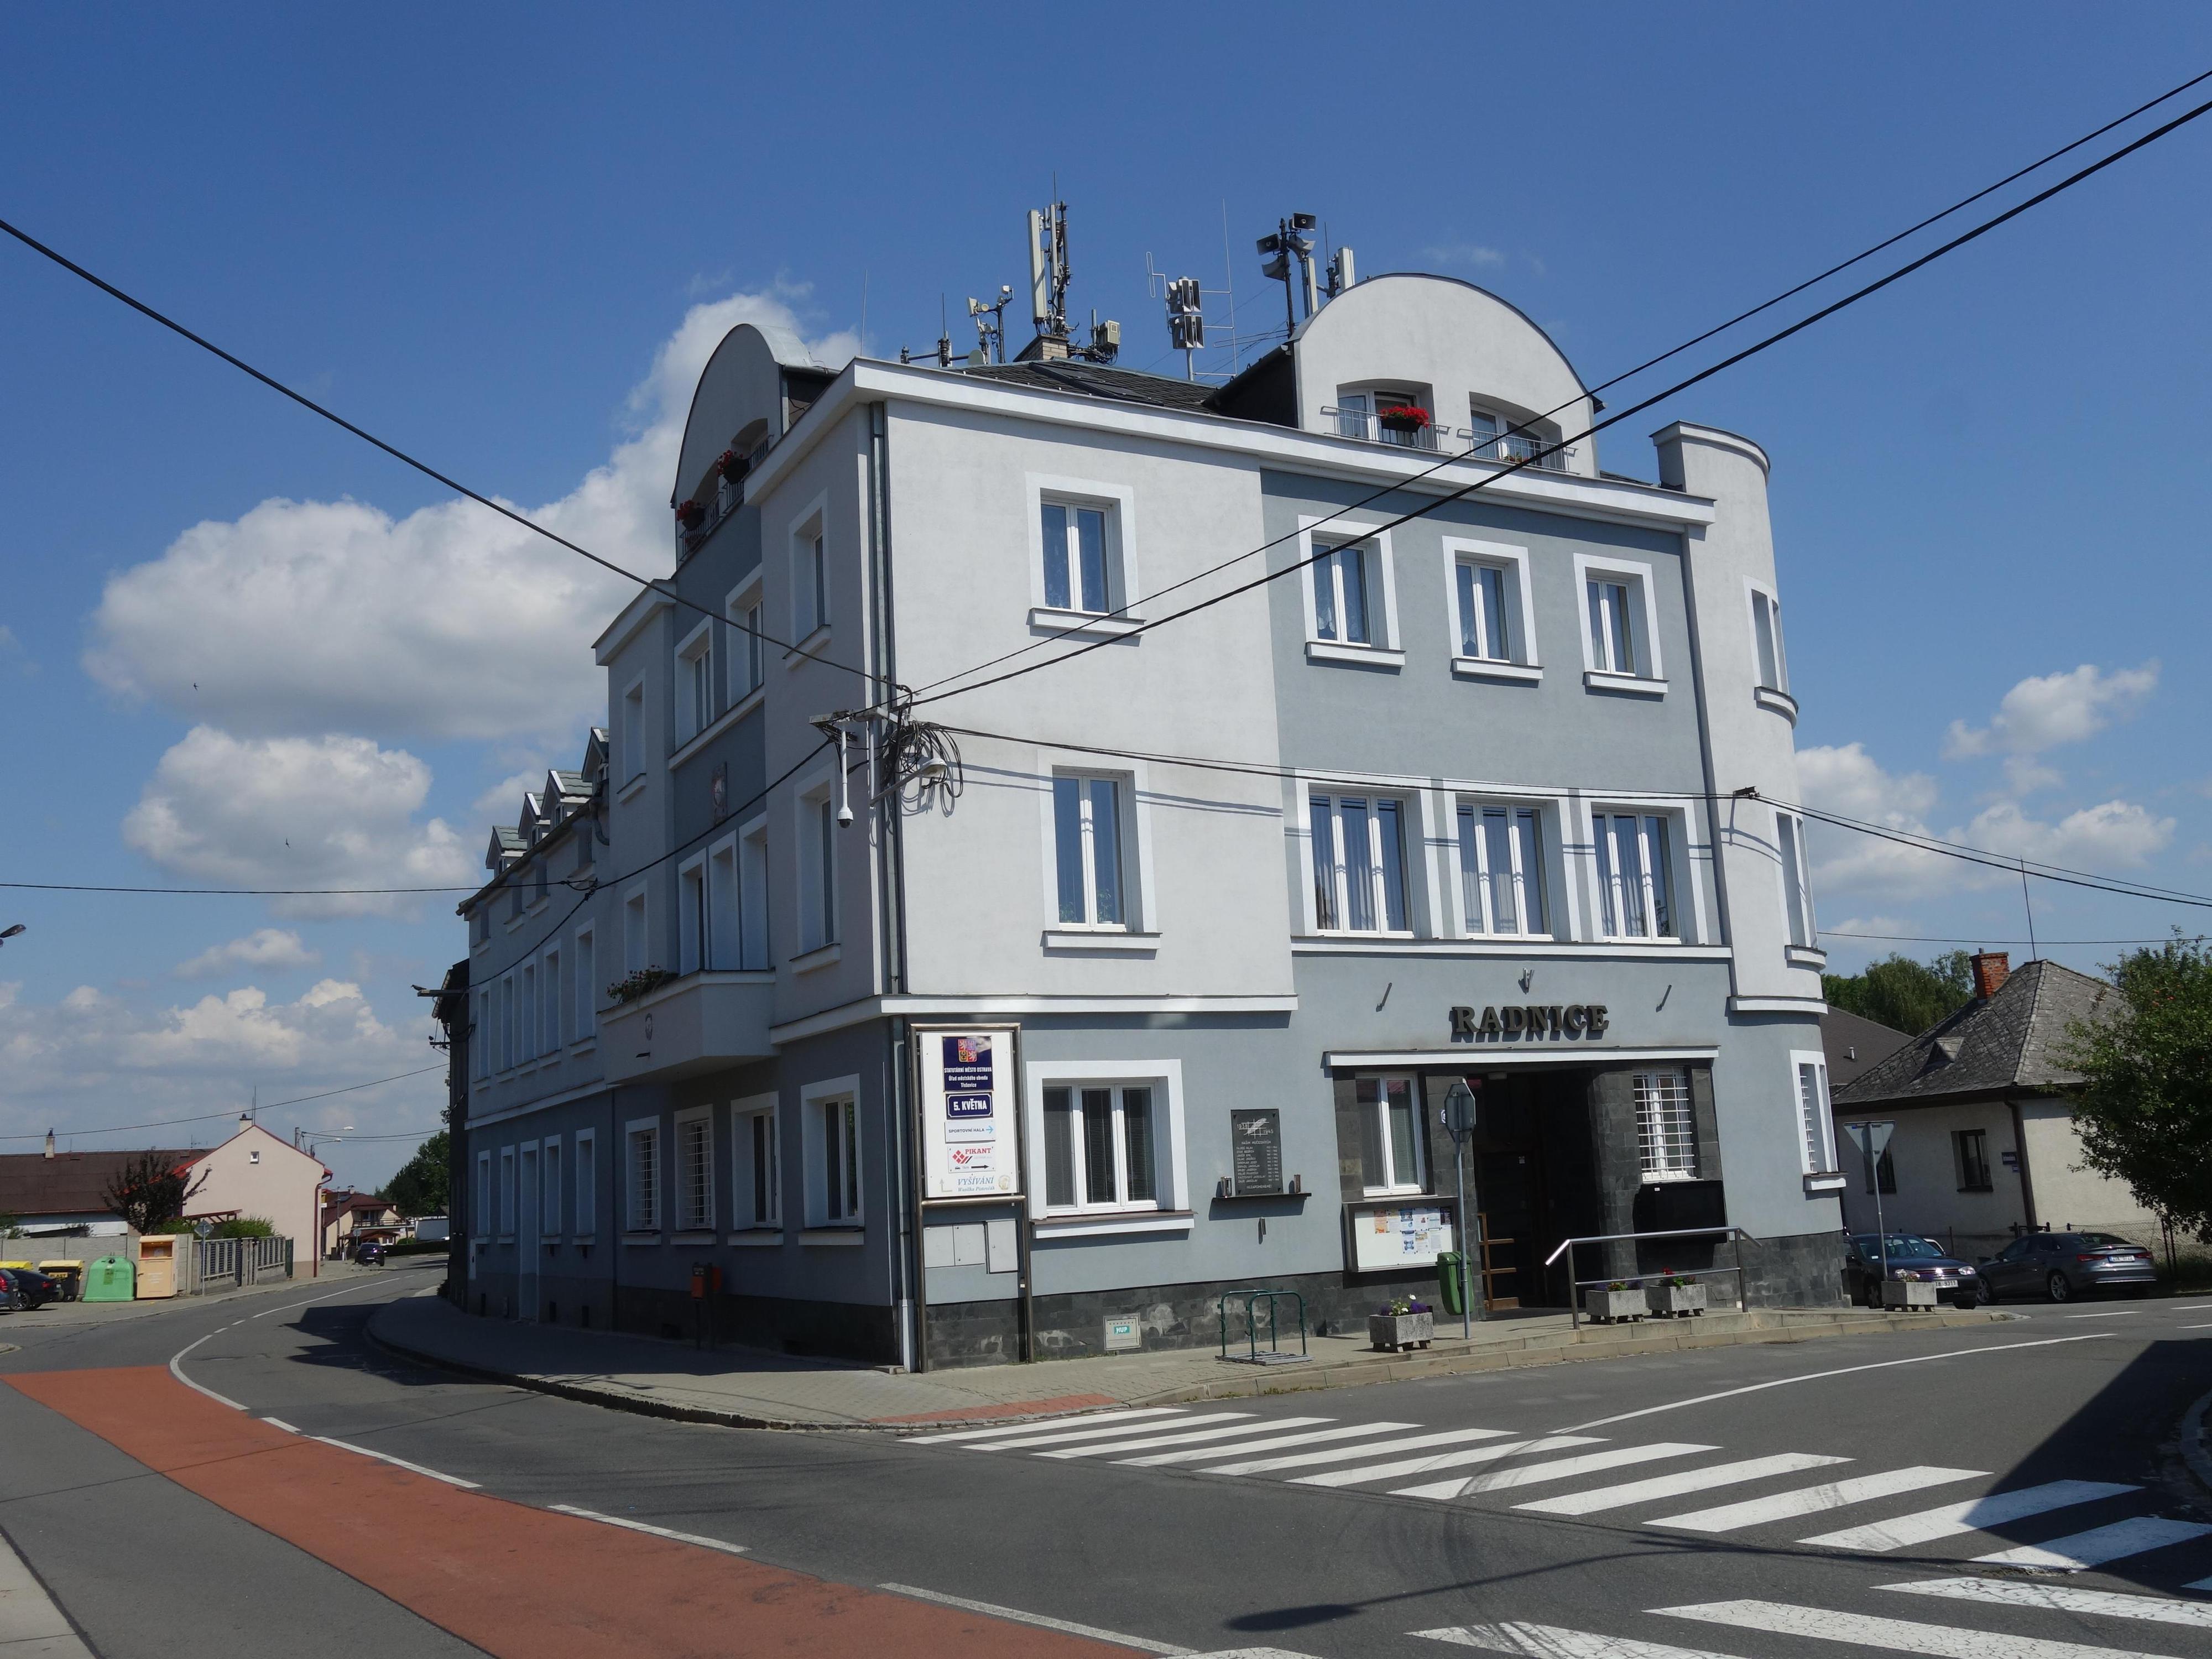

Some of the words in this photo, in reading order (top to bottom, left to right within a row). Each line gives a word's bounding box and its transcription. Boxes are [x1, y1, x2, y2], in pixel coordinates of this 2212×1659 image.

[1451, 1004, 1610, 1033] RADNICE
[953, 1101, 961, 1111] 5.
[961, 1098, 988, 1110] KVĚTNA
[958, 1176, 995, 1186] VYŠÍVÁNÍ
